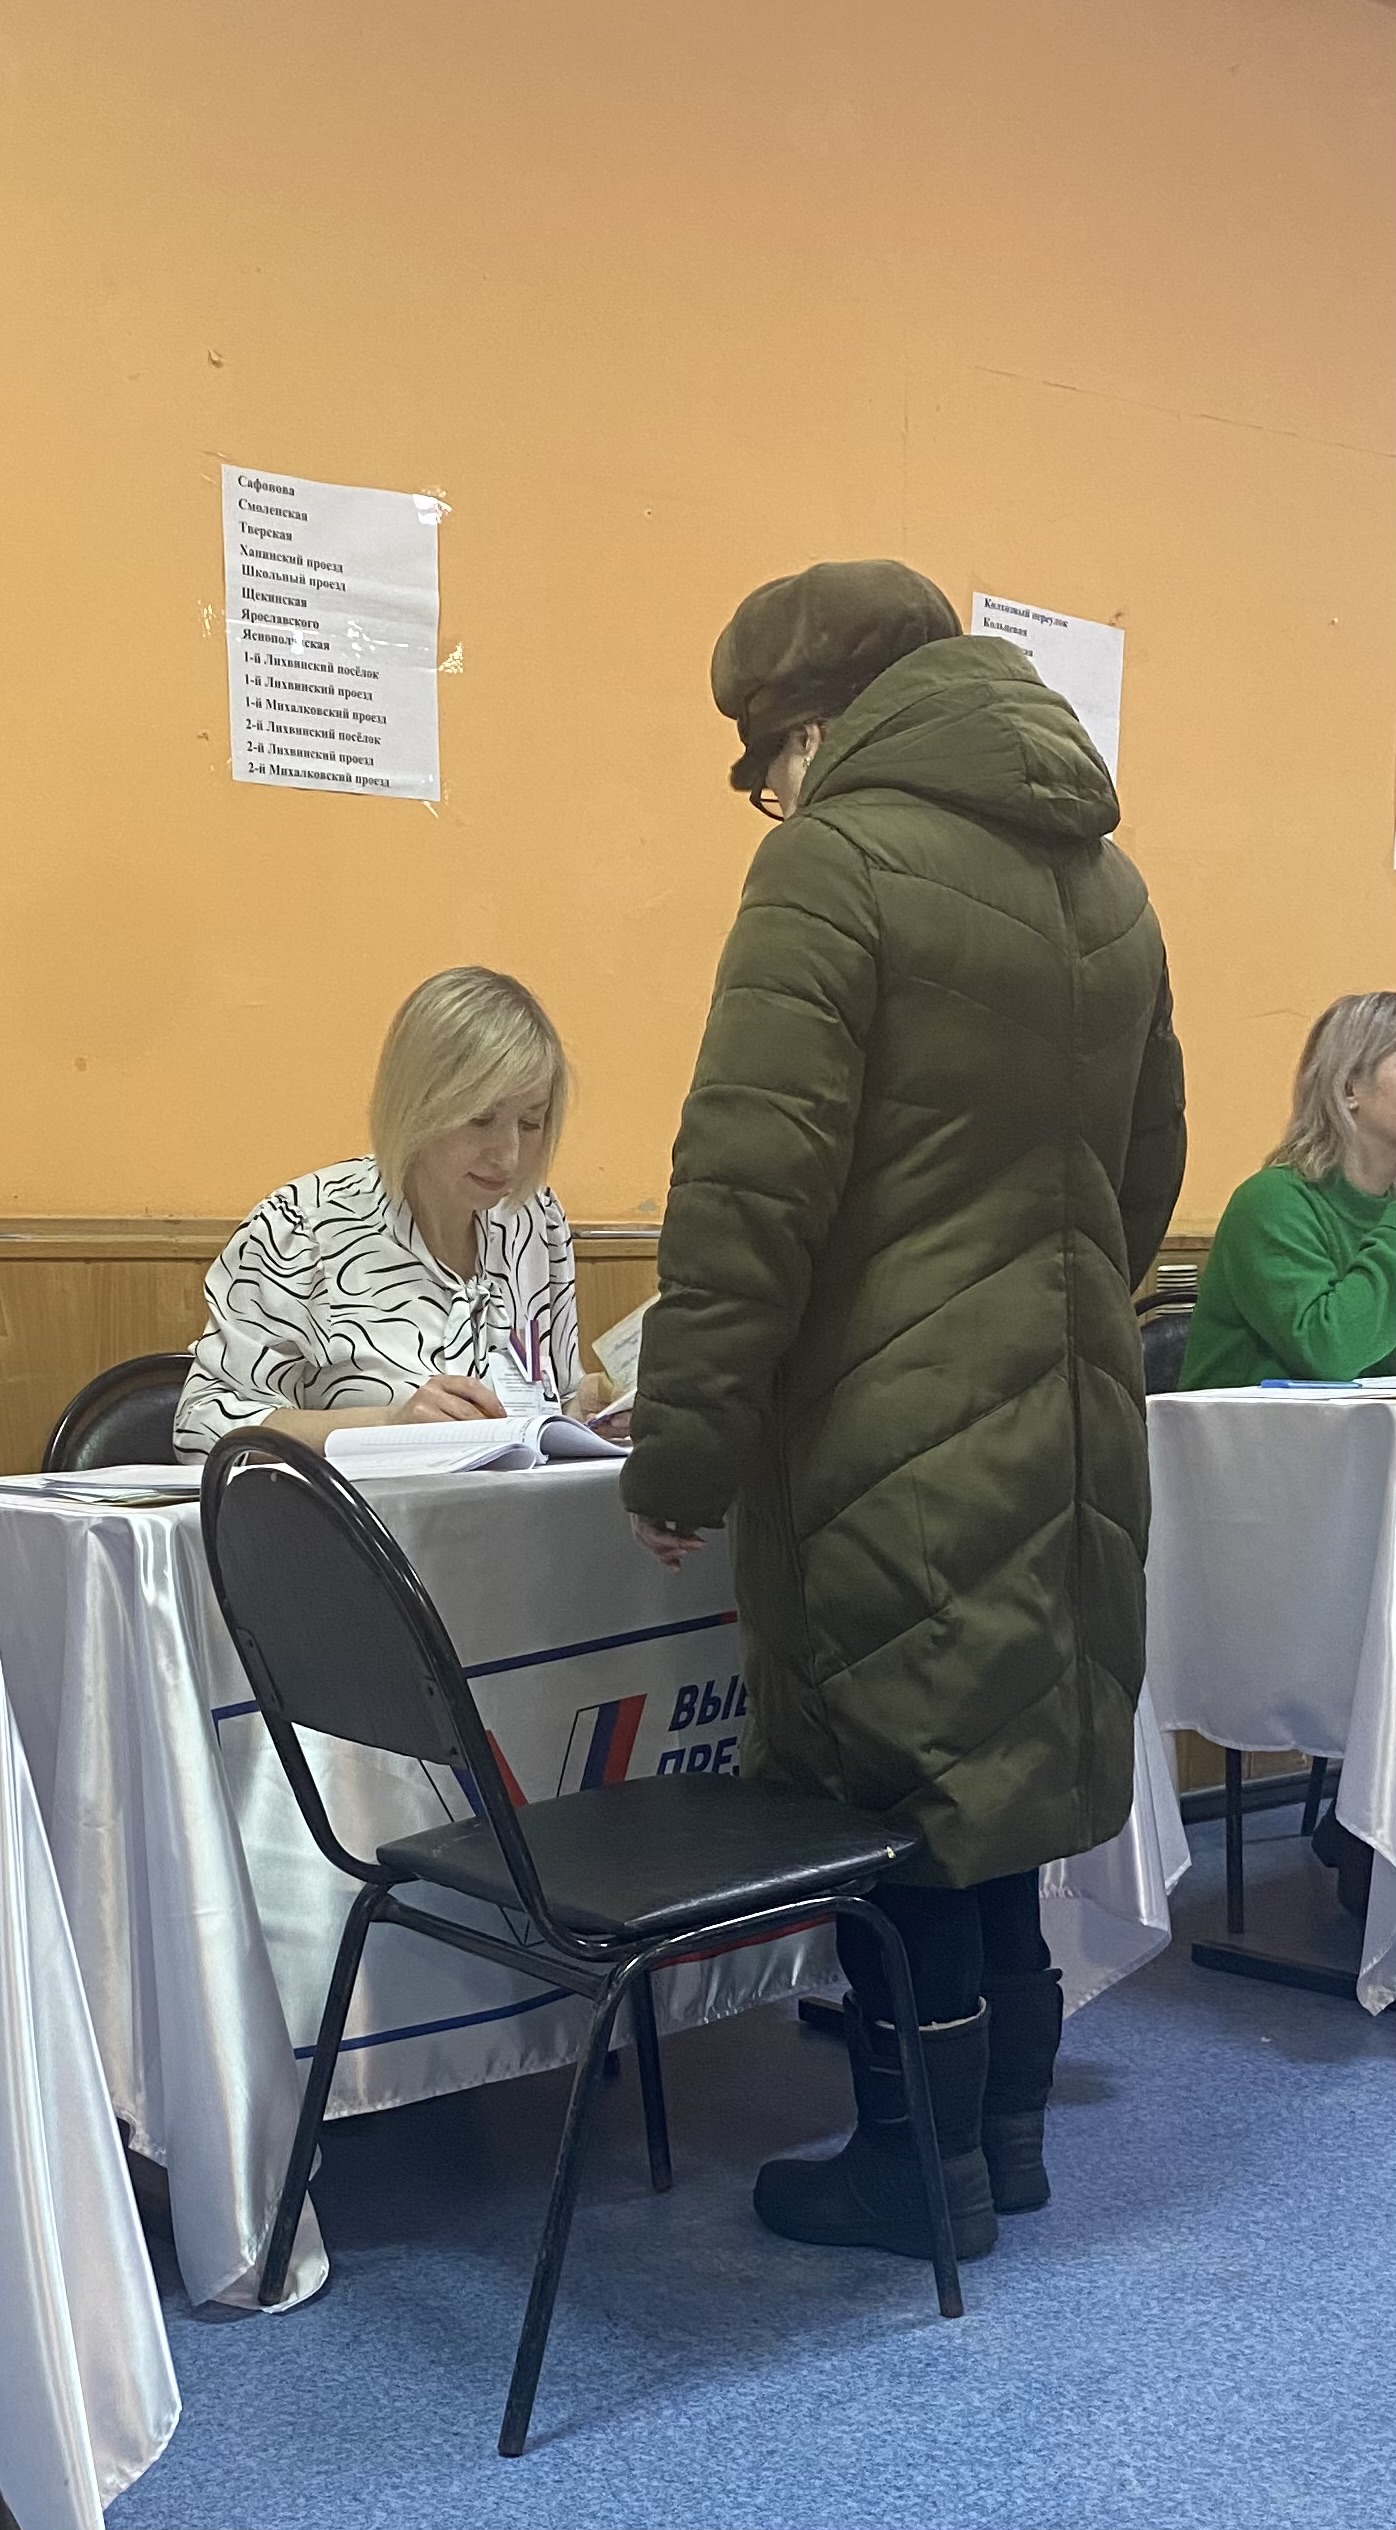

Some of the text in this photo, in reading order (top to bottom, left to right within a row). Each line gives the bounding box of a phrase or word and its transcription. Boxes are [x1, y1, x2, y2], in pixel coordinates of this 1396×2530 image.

[238, 475, 295, 496] Сафонова
[238, 499, 308, 522] Смоленская
[241, 522, 292, 541] Тверская
[240, 544, 344, 573] Ханинский проезд
[242, 564, 346, 592] Школьный проезд
[242, 587, 307, 608] Щекинская
[241, 608, 320, 630] Ярославского
[243, 628, 330, 651] Яснополская
[244, 651, 379, 680] 1-й Лихвинский посёлок
[245, 674, 373, 702] 1-й Лихвинский проезд
[246, 696, 387, 725] 1-й Михалковский проезд
[246, 718, 381, 745] 2-й Лихвинский посёлок
[247, 741, 374, 767] 2-й Лихвинский проезд
[248, 762, 390, 788] 2-й Михалковский проезд
[656, 1737, 740, 1775] ПРЕ
